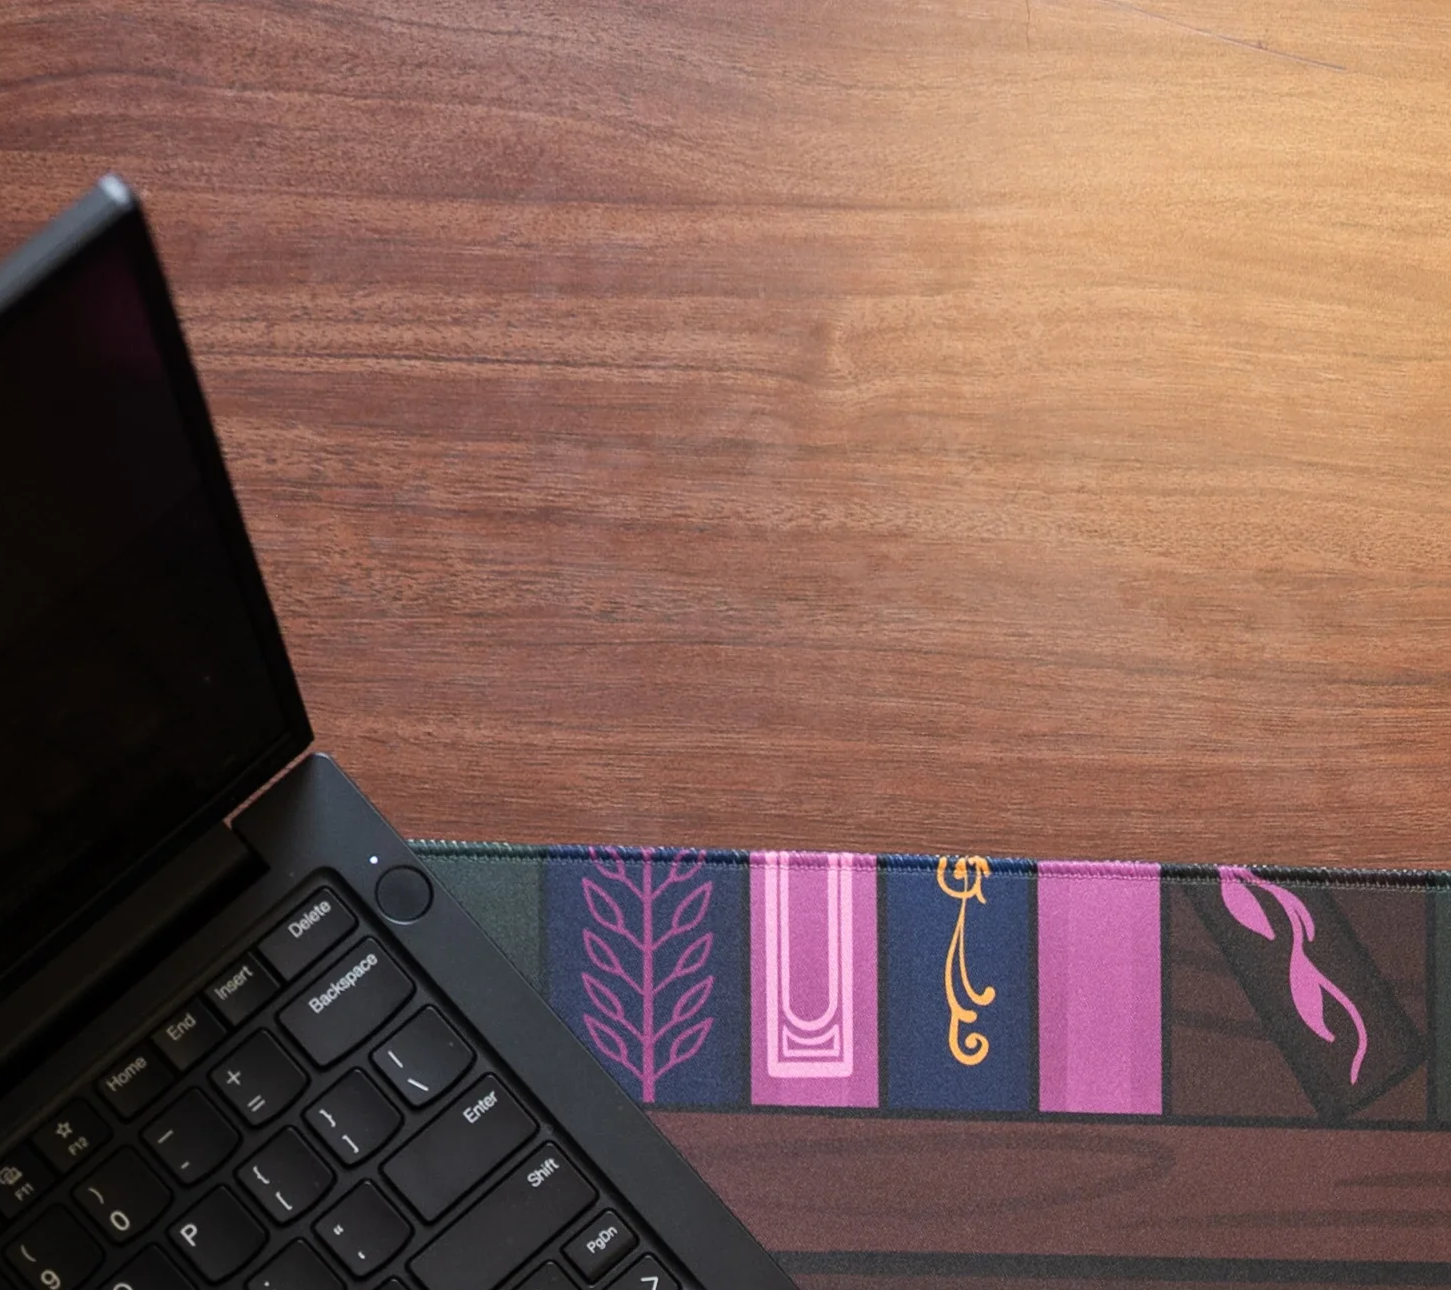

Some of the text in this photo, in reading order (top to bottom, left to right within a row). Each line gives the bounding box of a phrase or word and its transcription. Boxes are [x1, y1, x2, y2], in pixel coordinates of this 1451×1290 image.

[286, 900, 332, 939] Delete
[213, 965, 254, 1001] Insert
[307, 952, 379, 1014] Backspace
[165, 1012, 197, 1042] End
[105, 1056, 148, 1093] Home
[461, 1089, 498, 1124] Enter
[67, 1135, 89, 1157] F12
[526, 1157, 560, 1188] Shift
[13, 1182, 35, 1202] F11
[109, 1209, 131, 1232] 0
[179, 1222, 199, 1248] P
[585, 1225, 619, 1254] PgDn
